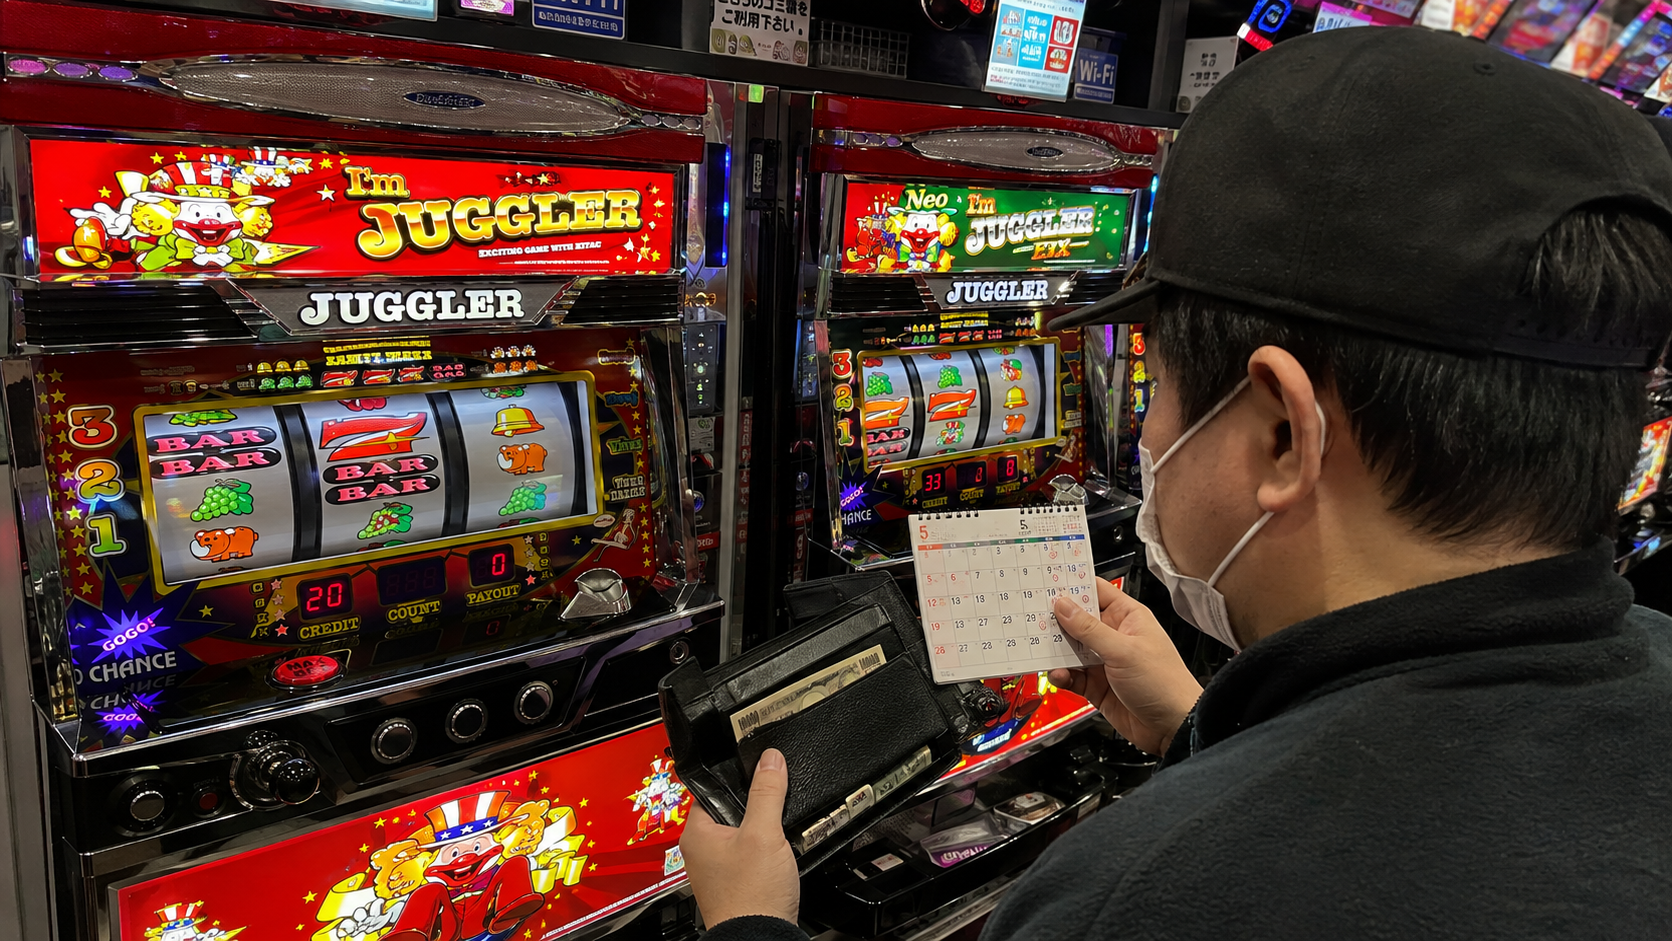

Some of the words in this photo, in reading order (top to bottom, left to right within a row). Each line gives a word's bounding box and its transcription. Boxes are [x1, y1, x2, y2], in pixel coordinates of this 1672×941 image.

[1080, 59, 1115, 85] Wi-Fi
[905, 190, 948, 210] Neo
[357, 189, 642, 259] JUGGLER
[964, 206, 1096, 256] JUGGLER
[947, 280, 1048, 303] JUGGLER
[300, 288, 525, 328] JUGGLER
[832, 350, 852, 378] 3
[834, 383, 853, 412] 2
[67, 405, 118, 448] 3
[838, 418, 854, 446] 1
[154, 429, 266, 453] BAR
[160, 450, 270, 477] BAR
[335, 457, 428, 481] BAR
[75, 459, 125, 502] 2
[338, 476, 432, 502] BAR
[925, 473, 941, 491] 33
[841, 509, 872, 526] HANCE
[85, 513, 127, 557] 1
[919, 525, 929, 540] 5
[492, 553, 506, 576] 0
[975, 571, 980, 579] 7
[306, 583, 342, 611] 20
[466, 584, 520, 606] PAYOUT
[387, 600, 441, 622] COUNT
[102, 617, 156, 652] GOGO!
[299, 618, 360, 640] CREDIT
[89, 651, 177, 682] CHANCE
